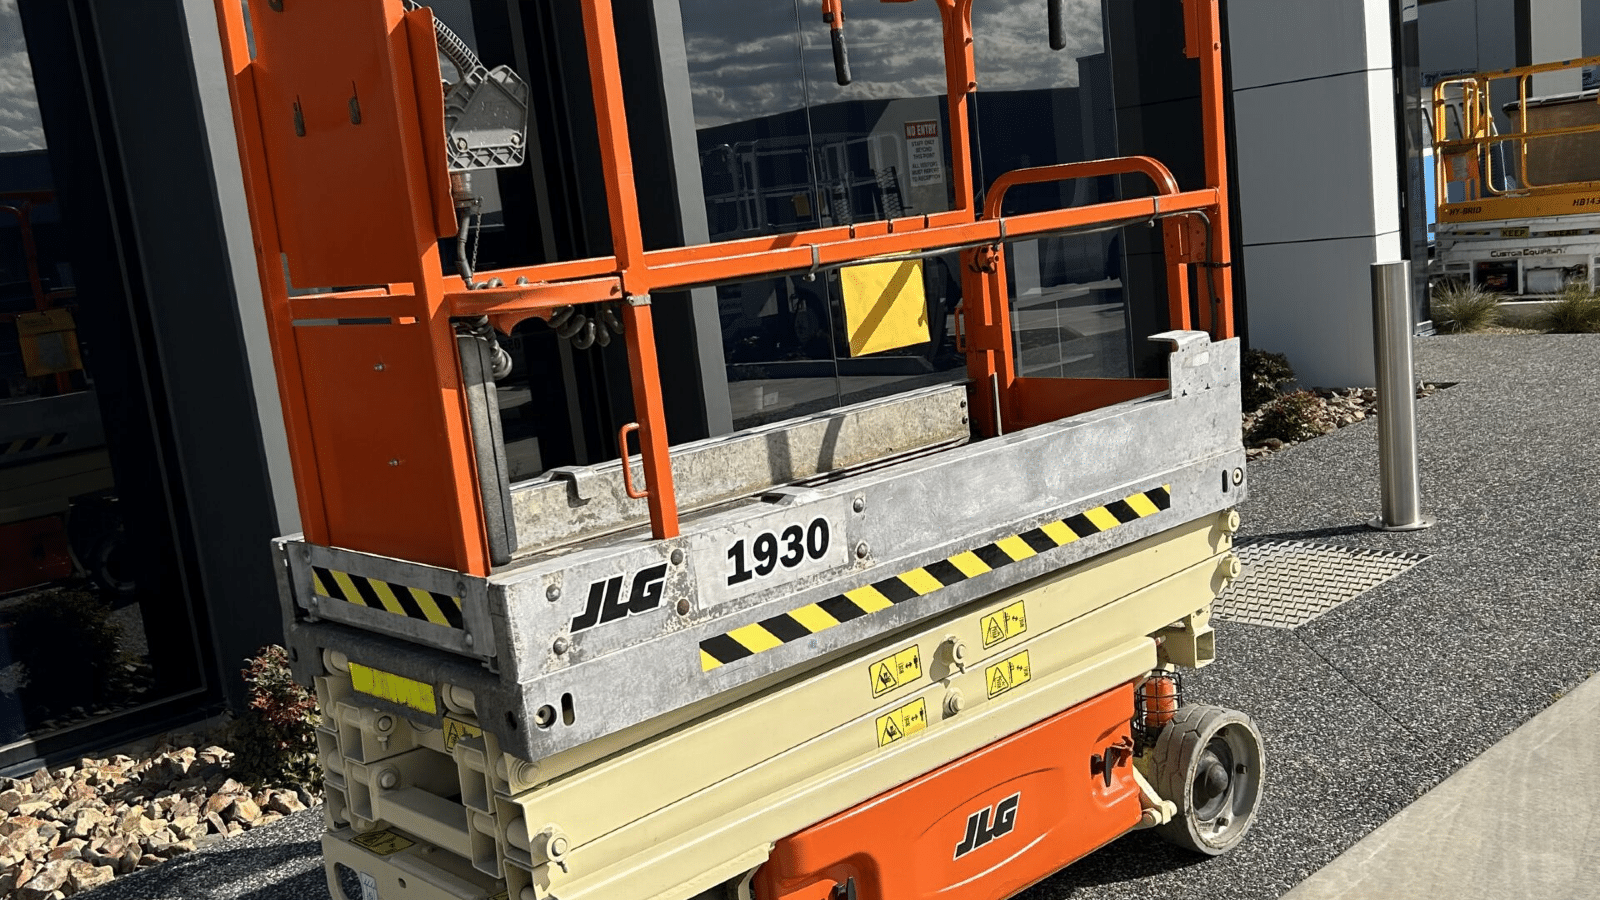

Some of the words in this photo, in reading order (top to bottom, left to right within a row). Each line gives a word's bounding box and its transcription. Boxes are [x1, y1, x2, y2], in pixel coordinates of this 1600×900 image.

[906, 125, 916, 137] NO
[917, 124, 937, 136] ENTRY
[1449, 206, 1482, 216] HY-BRID
[1502, 229, 1525, 237] KEEP
[727, 517, 830, 586] 1930
[569, 562, 669, 634] JLG
[953, 791, 1021, 861] JLG
